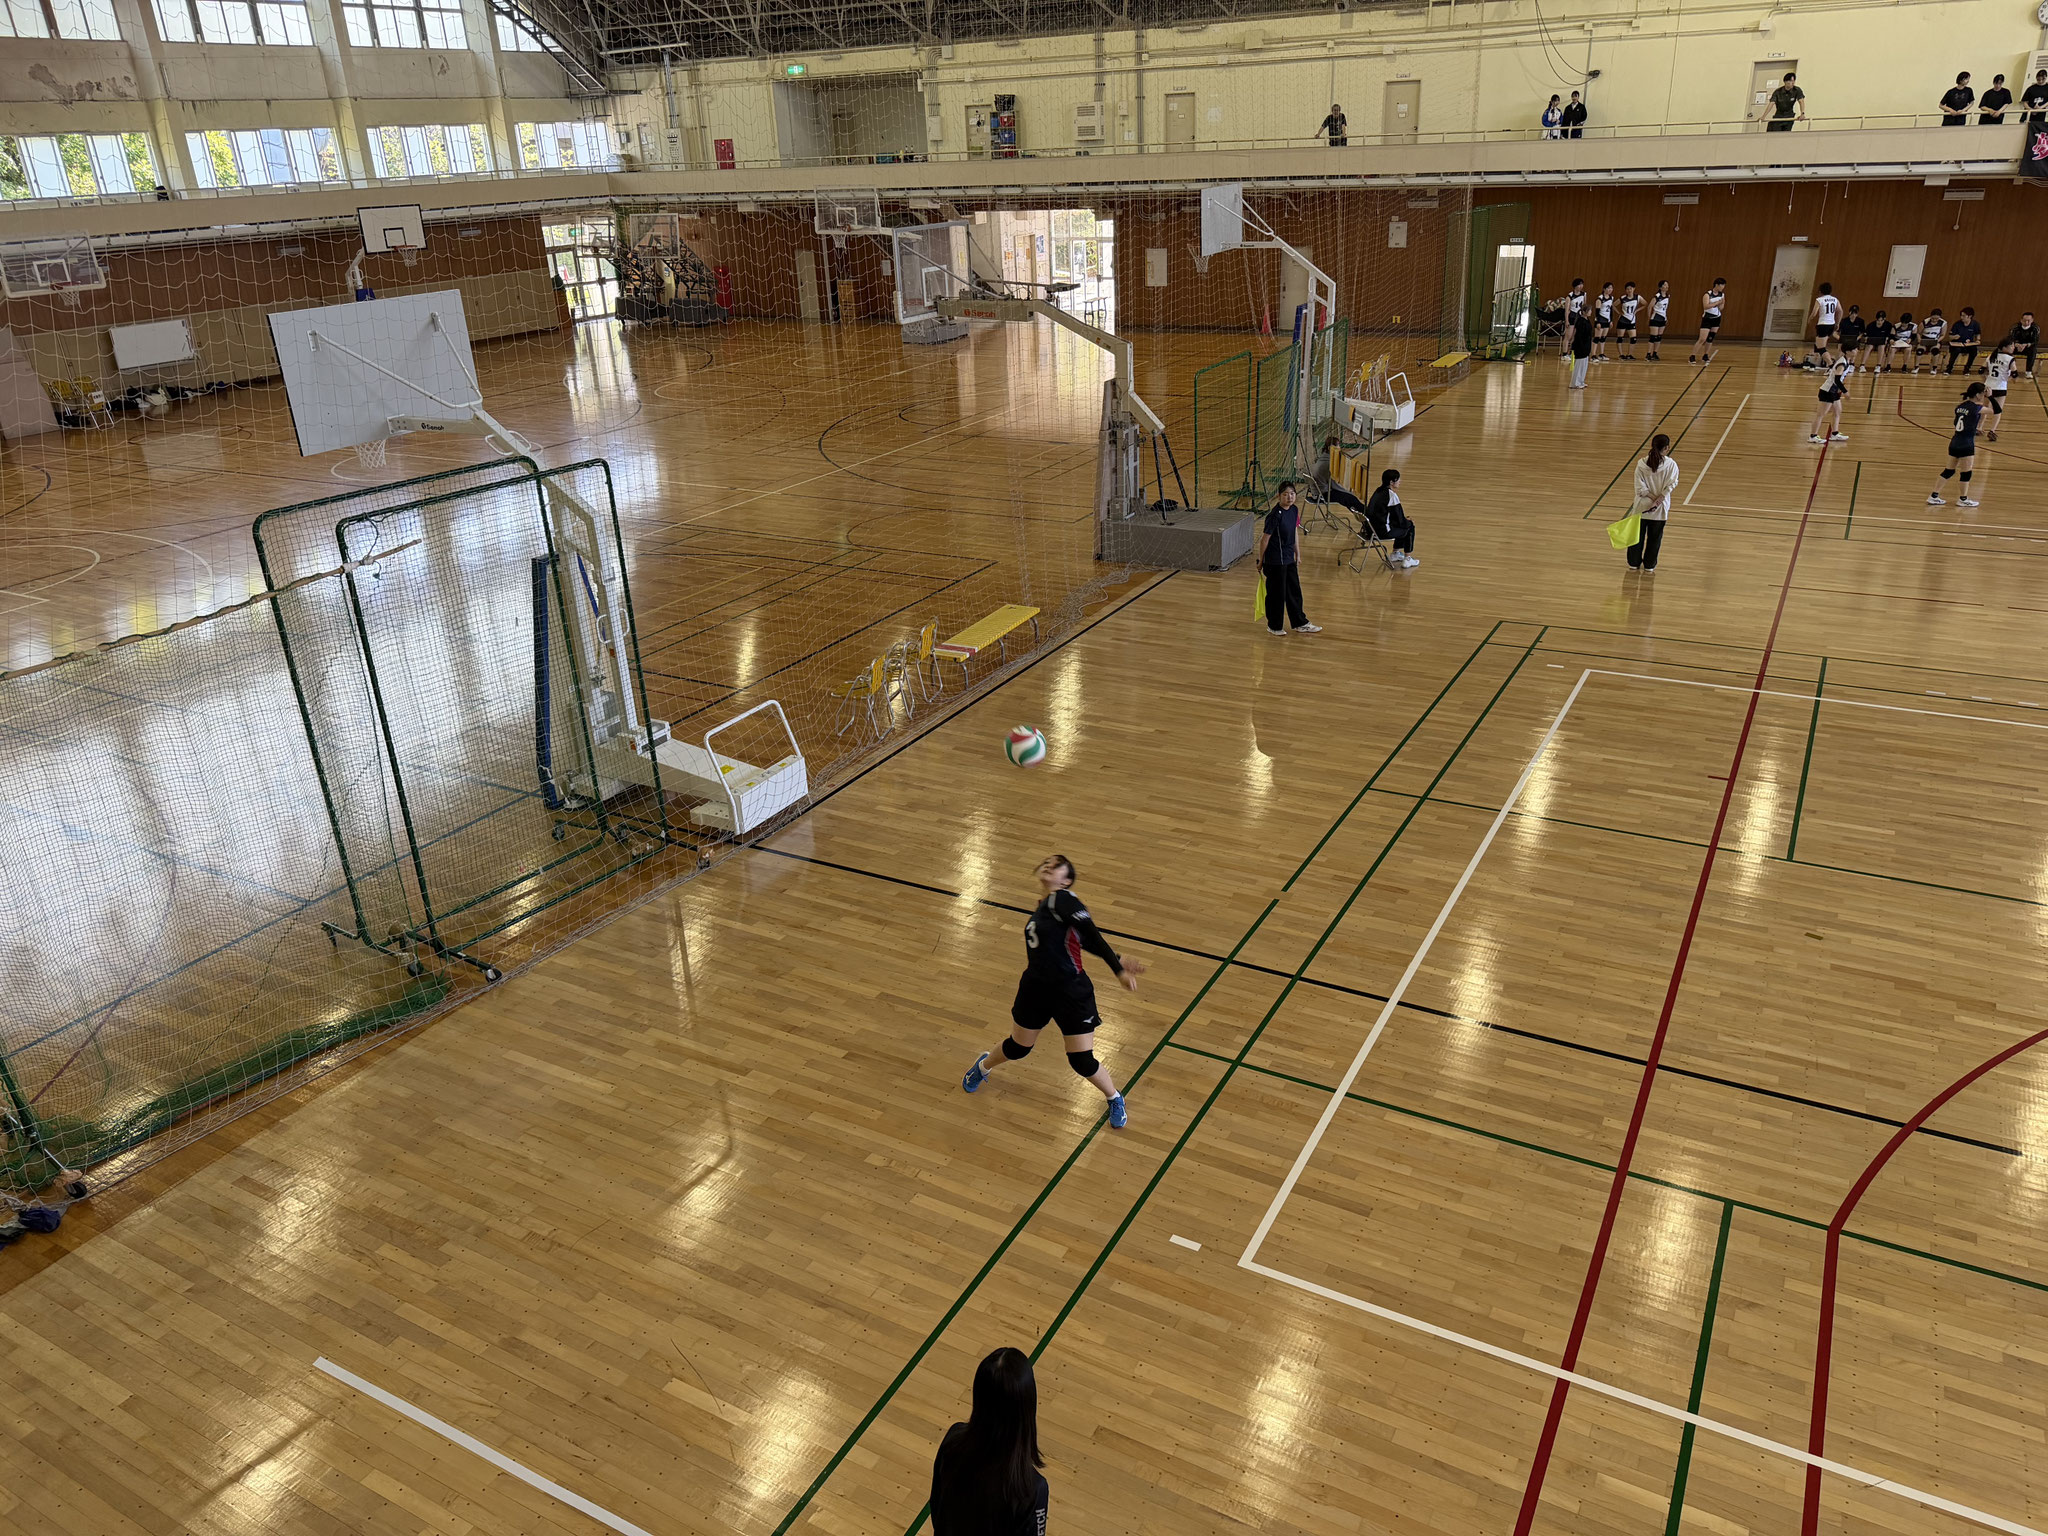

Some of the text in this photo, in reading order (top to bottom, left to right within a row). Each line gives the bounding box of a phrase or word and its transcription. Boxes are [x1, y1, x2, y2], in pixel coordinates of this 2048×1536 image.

[1825, 303, 1835, 314] 10
[1991, 366, 1999, 377] 5
[1956, 415, 1964, 432] 6
[1026, 921, 1039, 948] 3
